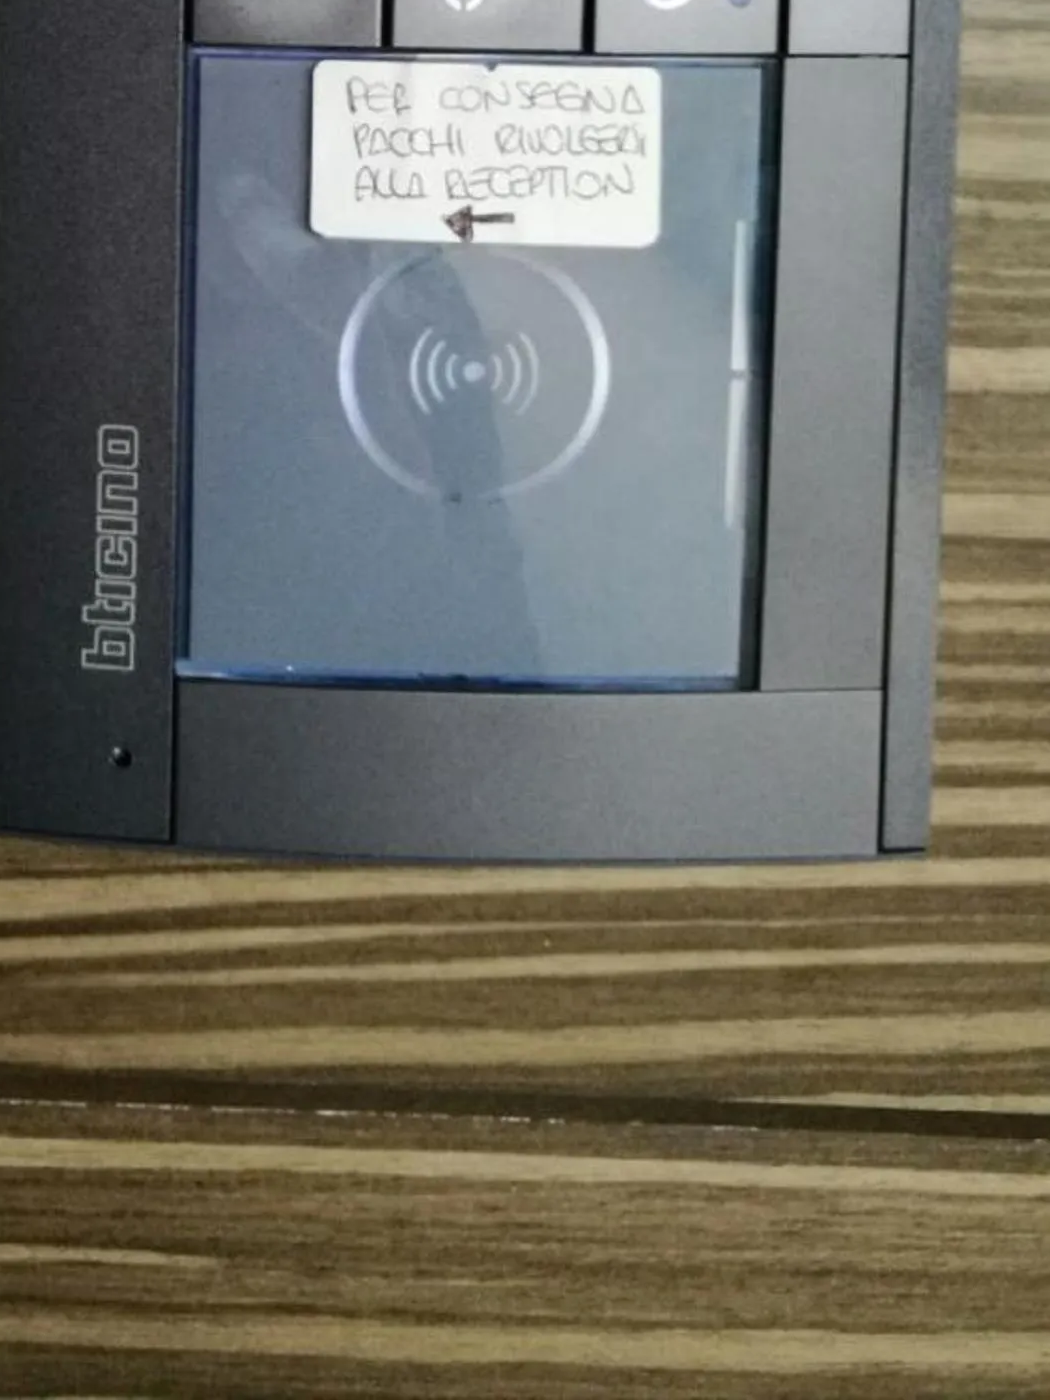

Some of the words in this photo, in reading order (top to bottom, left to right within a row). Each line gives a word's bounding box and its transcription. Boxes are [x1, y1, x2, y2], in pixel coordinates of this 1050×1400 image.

[345, 75, 412, 115] PER
[439, 80, 646, 114] CONSEGNA
[353, 122, 466, 160] PACCHI
[354, 165, 428, 202] ALLA
[444, 163, 636, 202] RECEPTION
[81, 424, 140, 671] bticino
